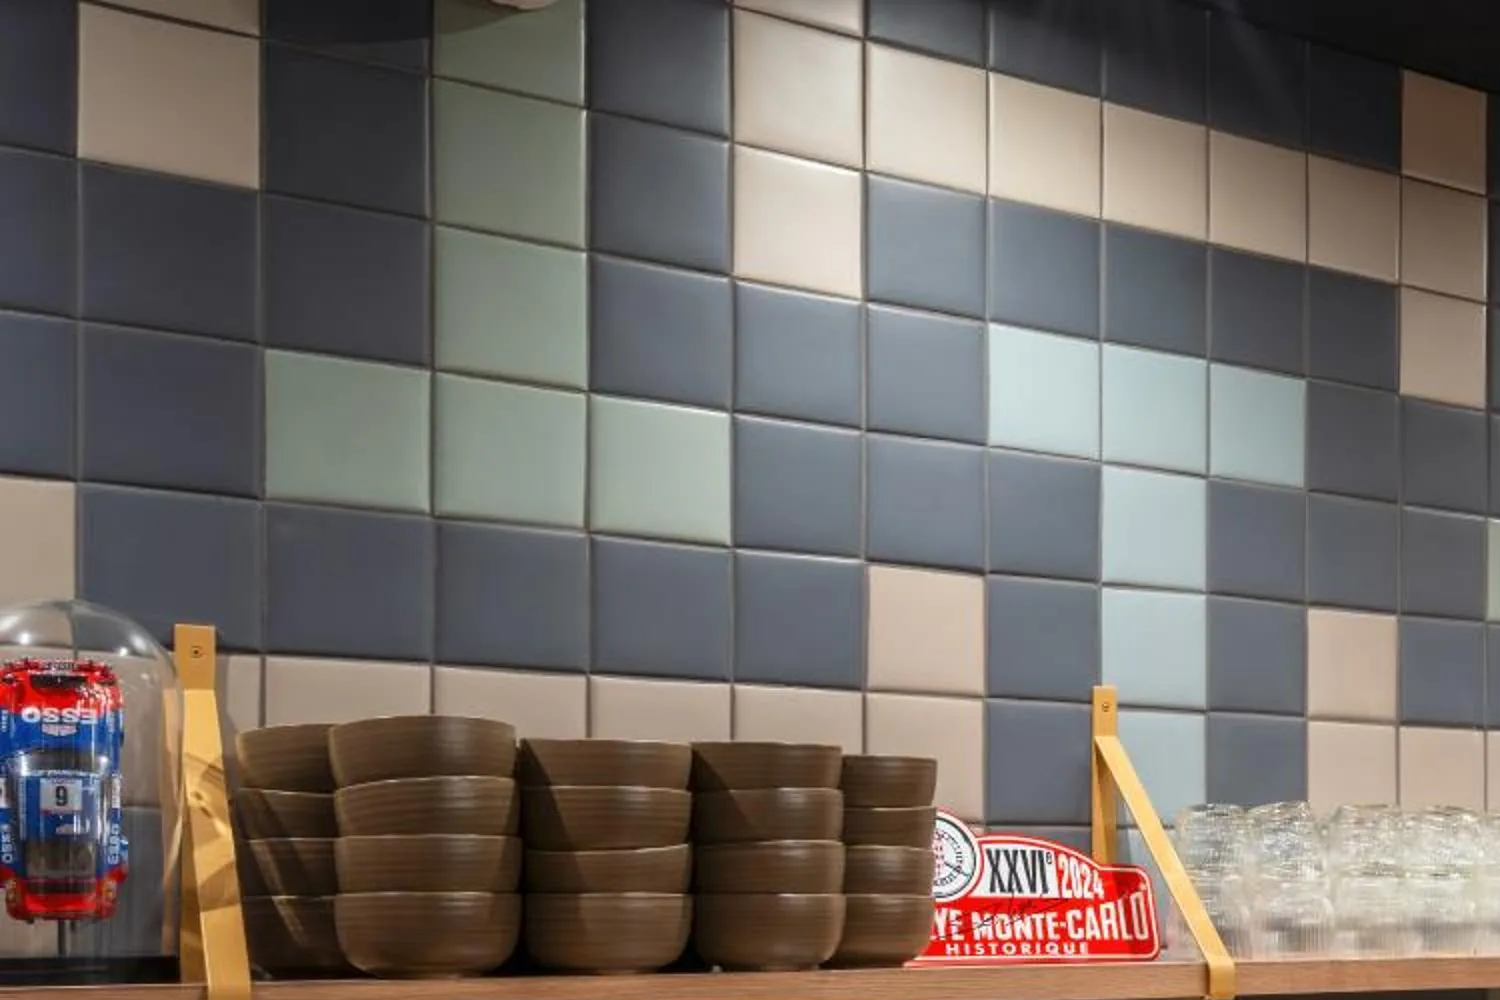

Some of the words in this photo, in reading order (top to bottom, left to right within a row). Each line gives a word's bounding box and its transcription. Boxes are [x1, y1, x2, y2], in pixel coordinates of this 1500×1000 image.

[22, 706, 98, 724] ESSO
[1057, 853, 1105, 900] 2024
[971, 891, 1150, 942] MONTE-CARLO
[944, 941, 1089, 956] HISTORIQUE
